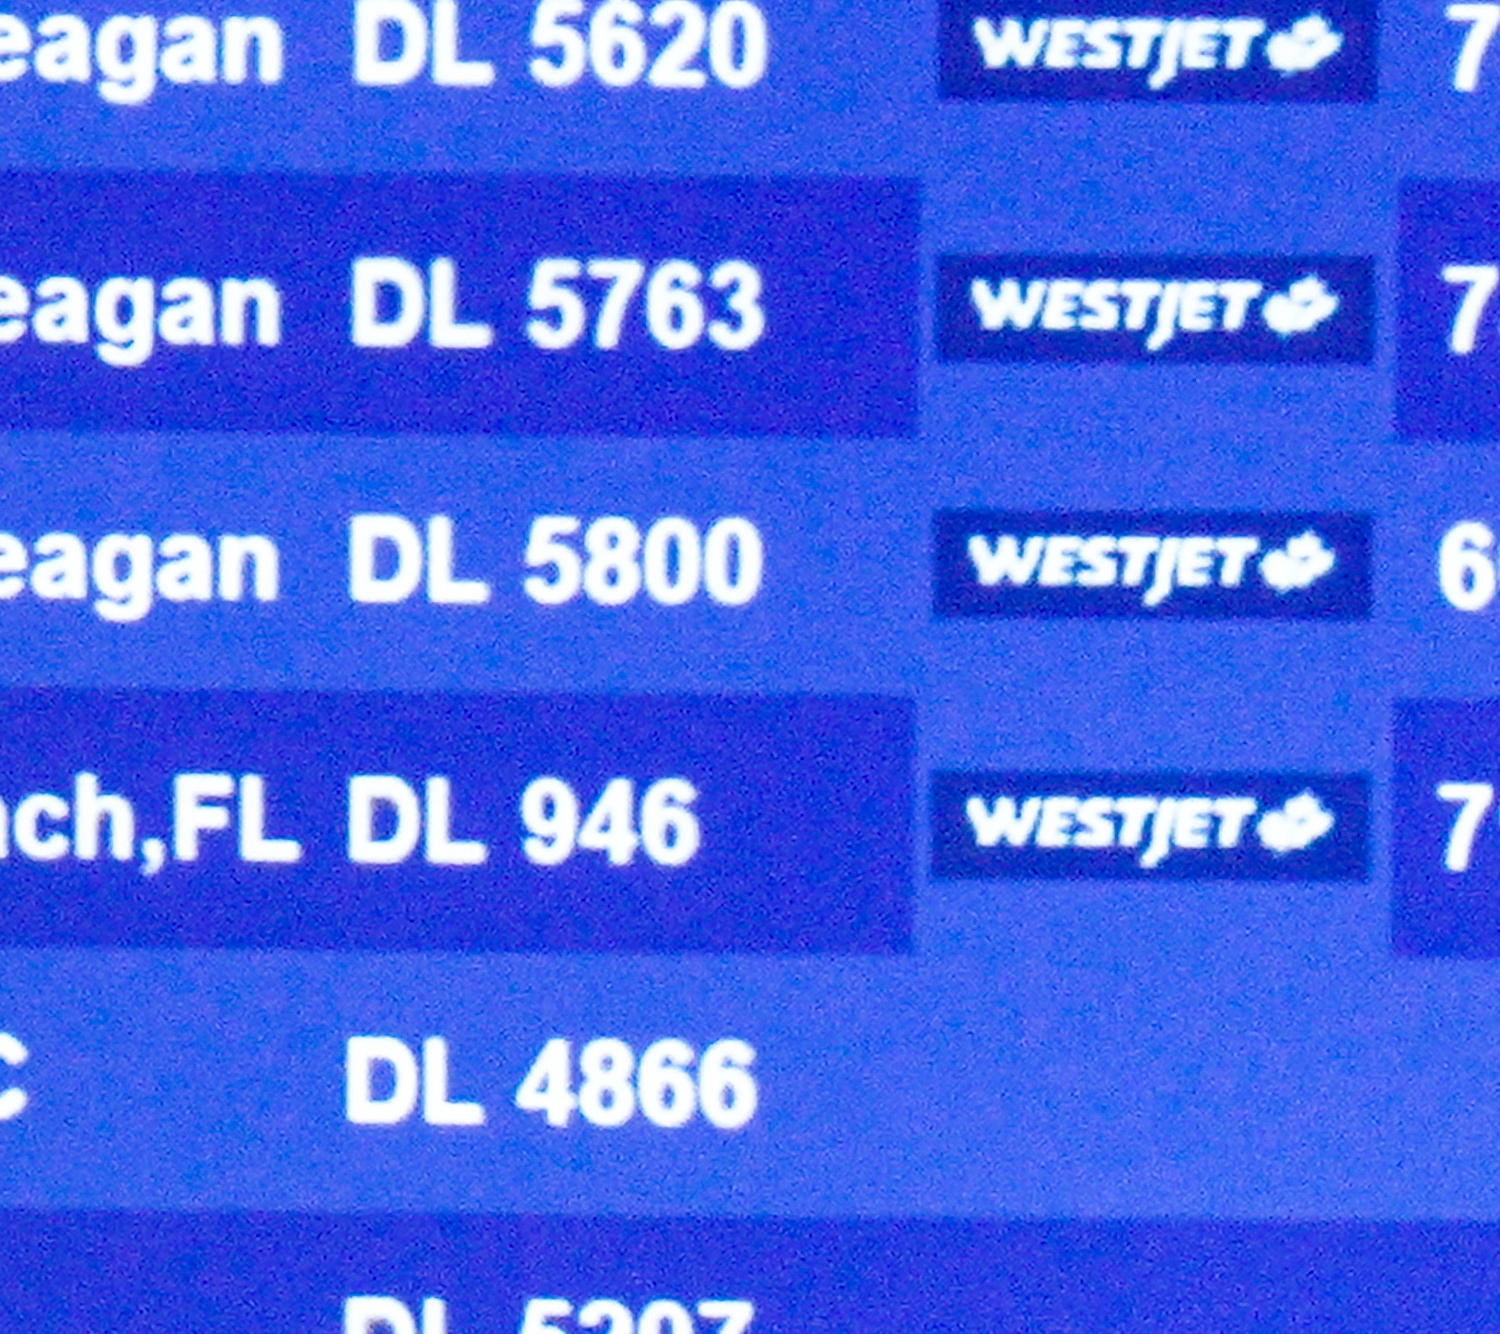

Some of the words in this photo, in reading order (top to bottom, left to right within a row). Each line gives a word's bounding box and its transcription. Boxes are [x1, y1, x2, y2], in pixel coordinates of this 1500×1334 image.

[973, 15, 1266, 90] WESTJET
[351, 255, 495, 351] DL
[526, 257, 767, 352] 5763
[970, 278, 1264, 352] WESTJET
[348, 512, 494, 607] DL
[522, 514, 766, 608] 5800
[967, 534, 1260, 607] WESTJET
[347, 774, 490, 868] DL
[519, 775, 702, 868] 946
[965, 795, 1258, 870] WESTJET
[343, 1034, 489, 1129] DL
[514, 1036, 761, 1133] 4866
